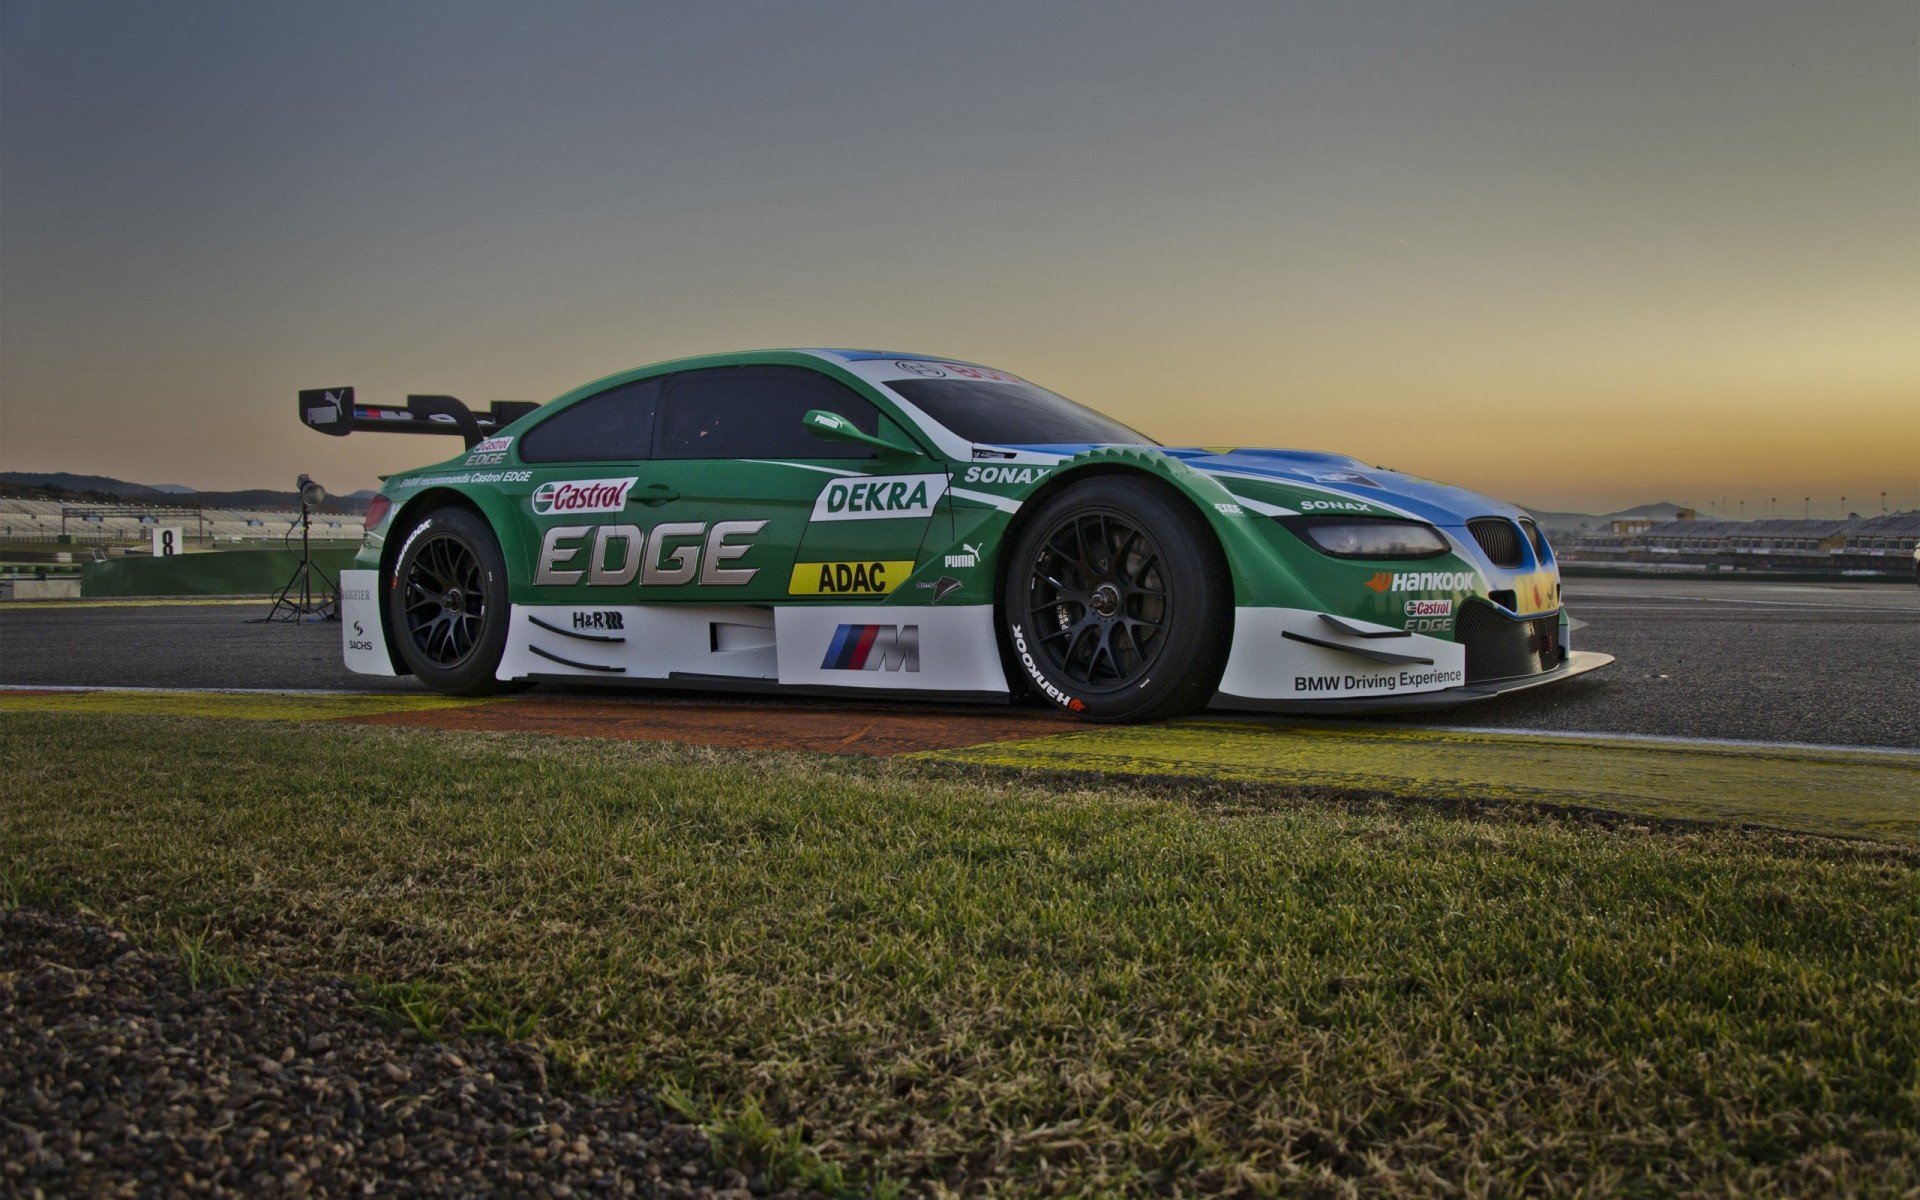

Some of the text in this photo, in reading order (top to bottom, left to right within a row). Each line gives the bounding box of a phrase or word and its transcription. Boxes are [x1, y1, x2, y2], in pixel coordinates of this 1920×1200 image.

[814, 414, 840, 429] PUMA
[464, 453, 508, 466] EDGE
[420, 473, 471, 485] recommends
[470, 471, 504, 483] Castrol
[502, 470, 534, 482] EDGE
[554, 482, 628, 510] Castrol
[827, 480, 928, 513] DEKRA
[1300, 500, 1372, 512] SONAX
[163, 530, 173, 557] 8
[533, 520, 771, 586] EDGE
[944, 554, 975, 568] PUMA
[818, 563, 886, 592] ADAC
[1417, 602, 1450, 615] Castrol
[573, 611, 608, 630] H&R
[1404, 618, 1453, 632] EDGE
[350, 640, 373, 651] SACHS
[1294, 669, 1462, 691] BMW Driving Experience
